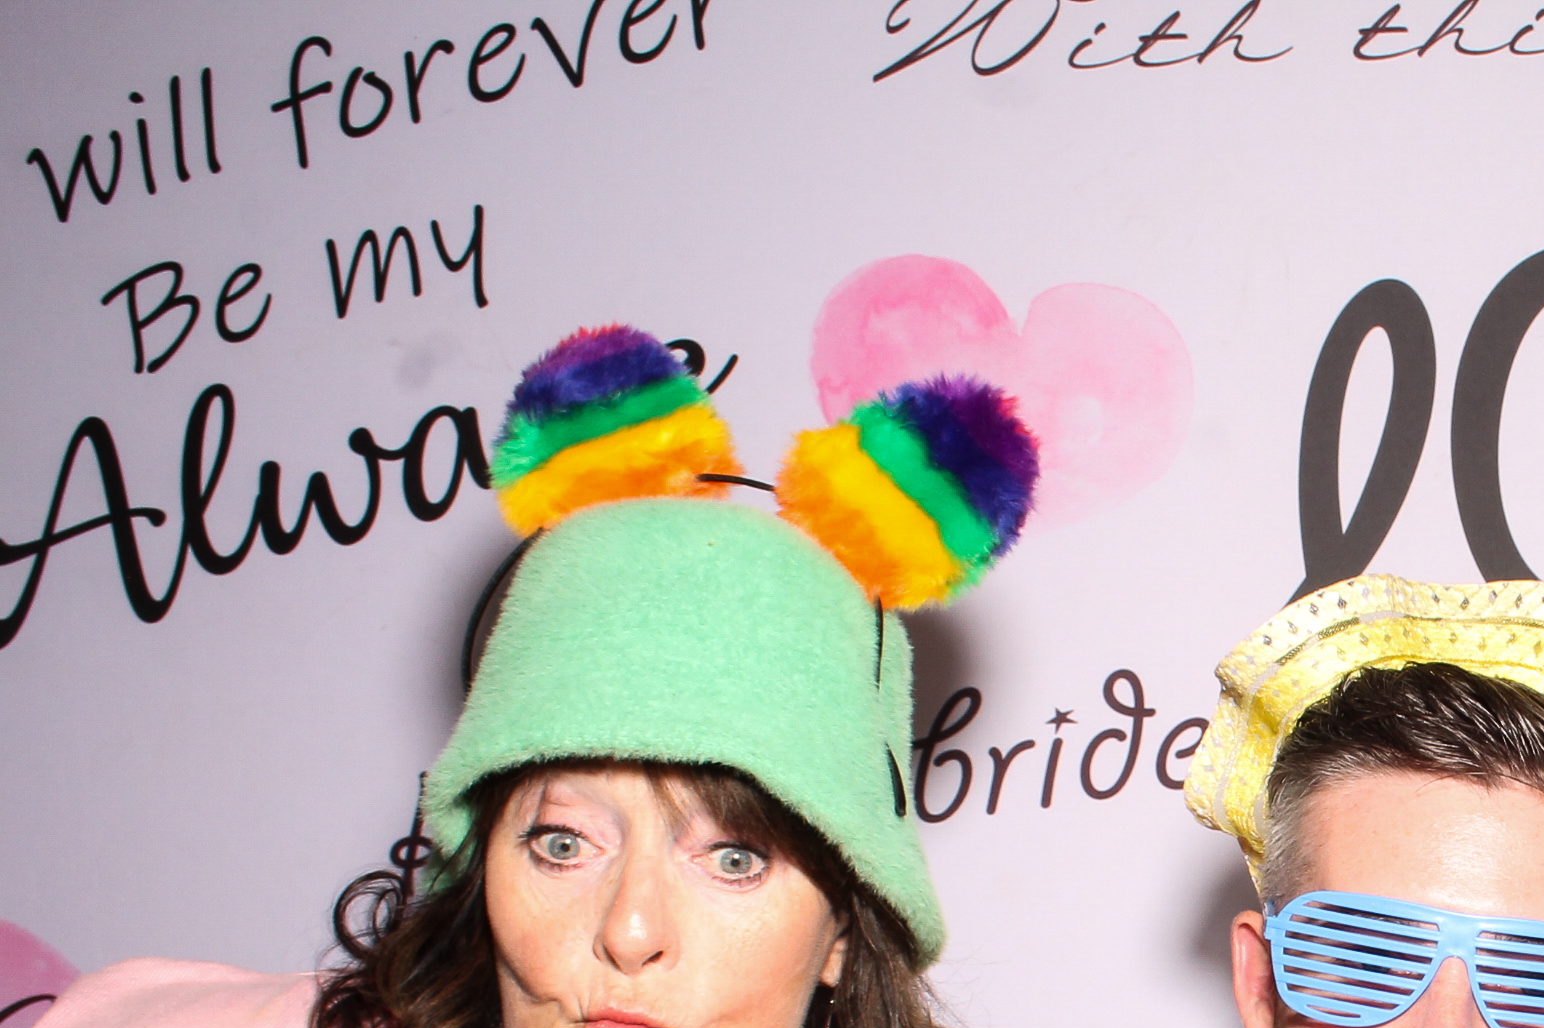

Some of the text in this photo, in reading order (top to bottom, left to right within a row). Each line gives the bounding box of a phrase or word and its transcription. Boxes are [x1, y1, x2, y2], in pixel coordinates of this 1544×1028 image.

[872, 0, 1294, 82] With
[27, 67, 221, 223] will
[101, 204, 488, 374] Be my
[0, 339, 739, 650] Alwa
